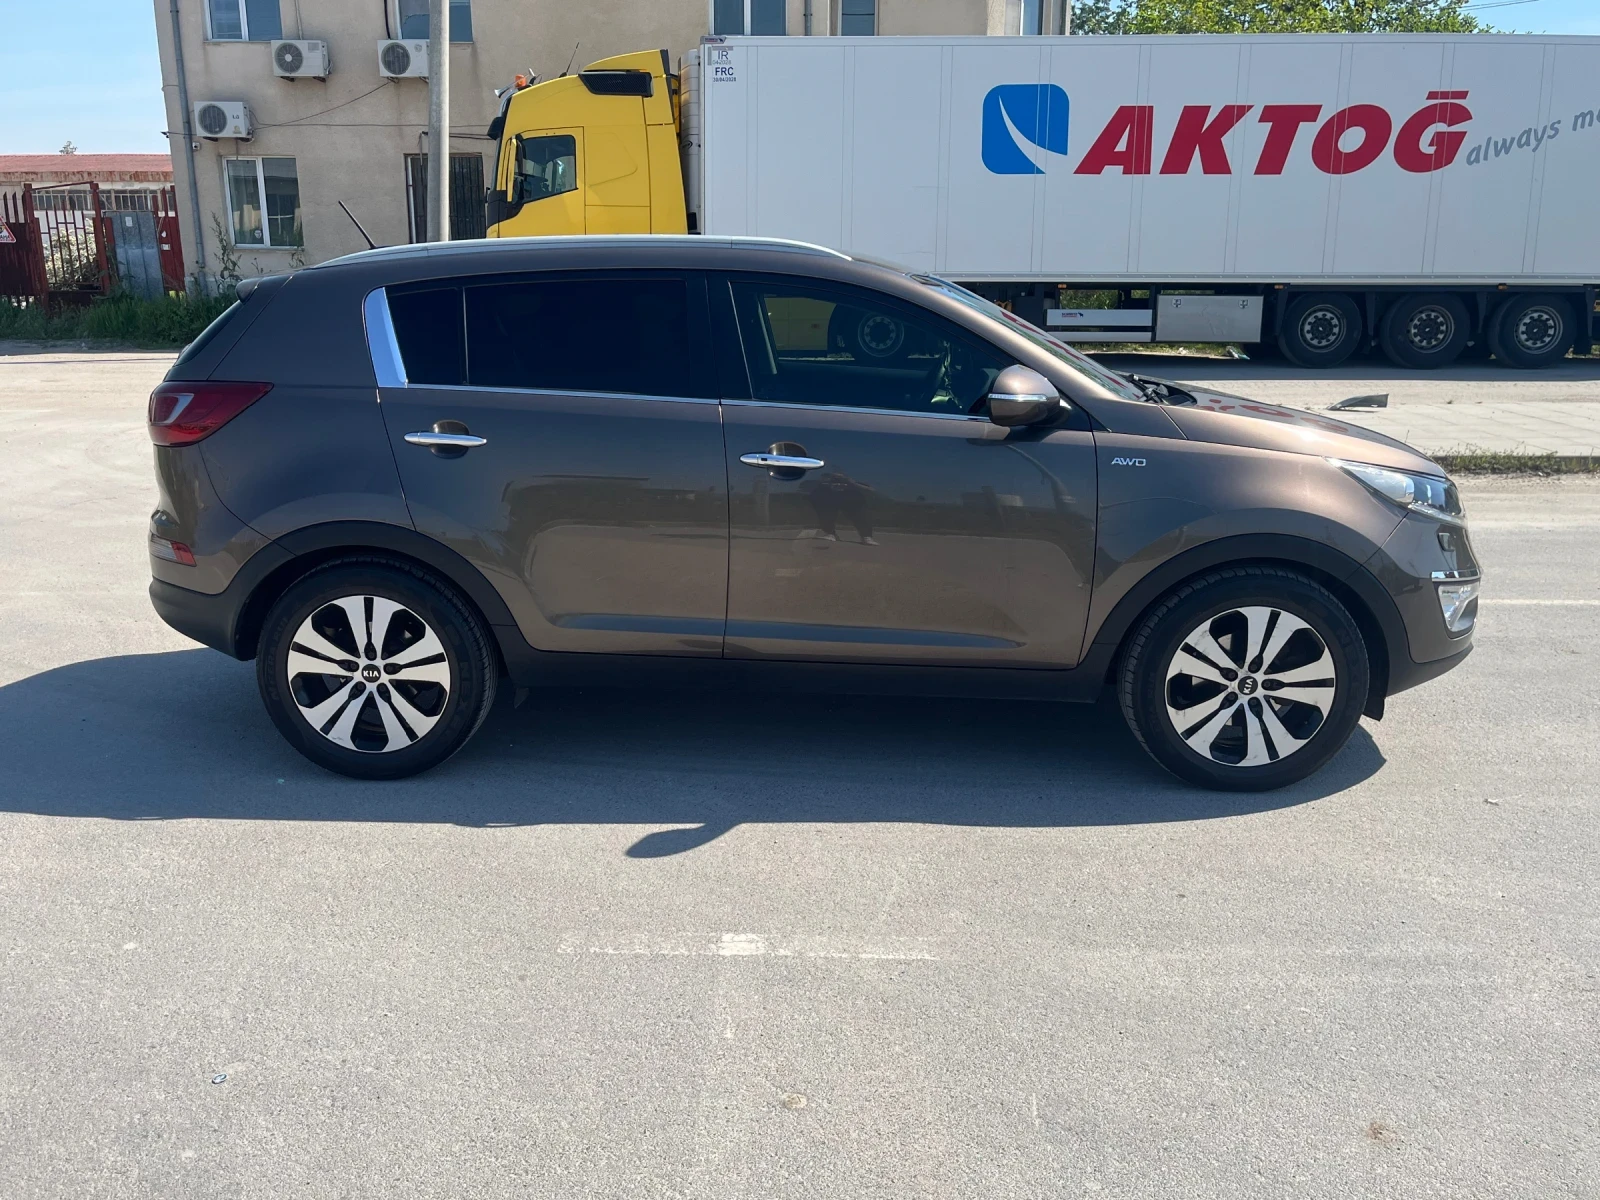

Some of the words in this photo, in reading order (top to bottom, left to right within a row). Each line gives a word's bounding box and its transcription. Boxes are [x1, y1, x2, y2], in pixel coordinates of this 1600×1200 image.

[717, 50, 729, 60] IR
[715, 66, 734, 76] FRC
[1465, 119, 1561, 166] always
[1571, 108, 1600, 132] m
[1111, 457, 1147, 467] AWD
[363, 670, 380, 678] KIA
[1242, 678, 1254, 694] KIA
